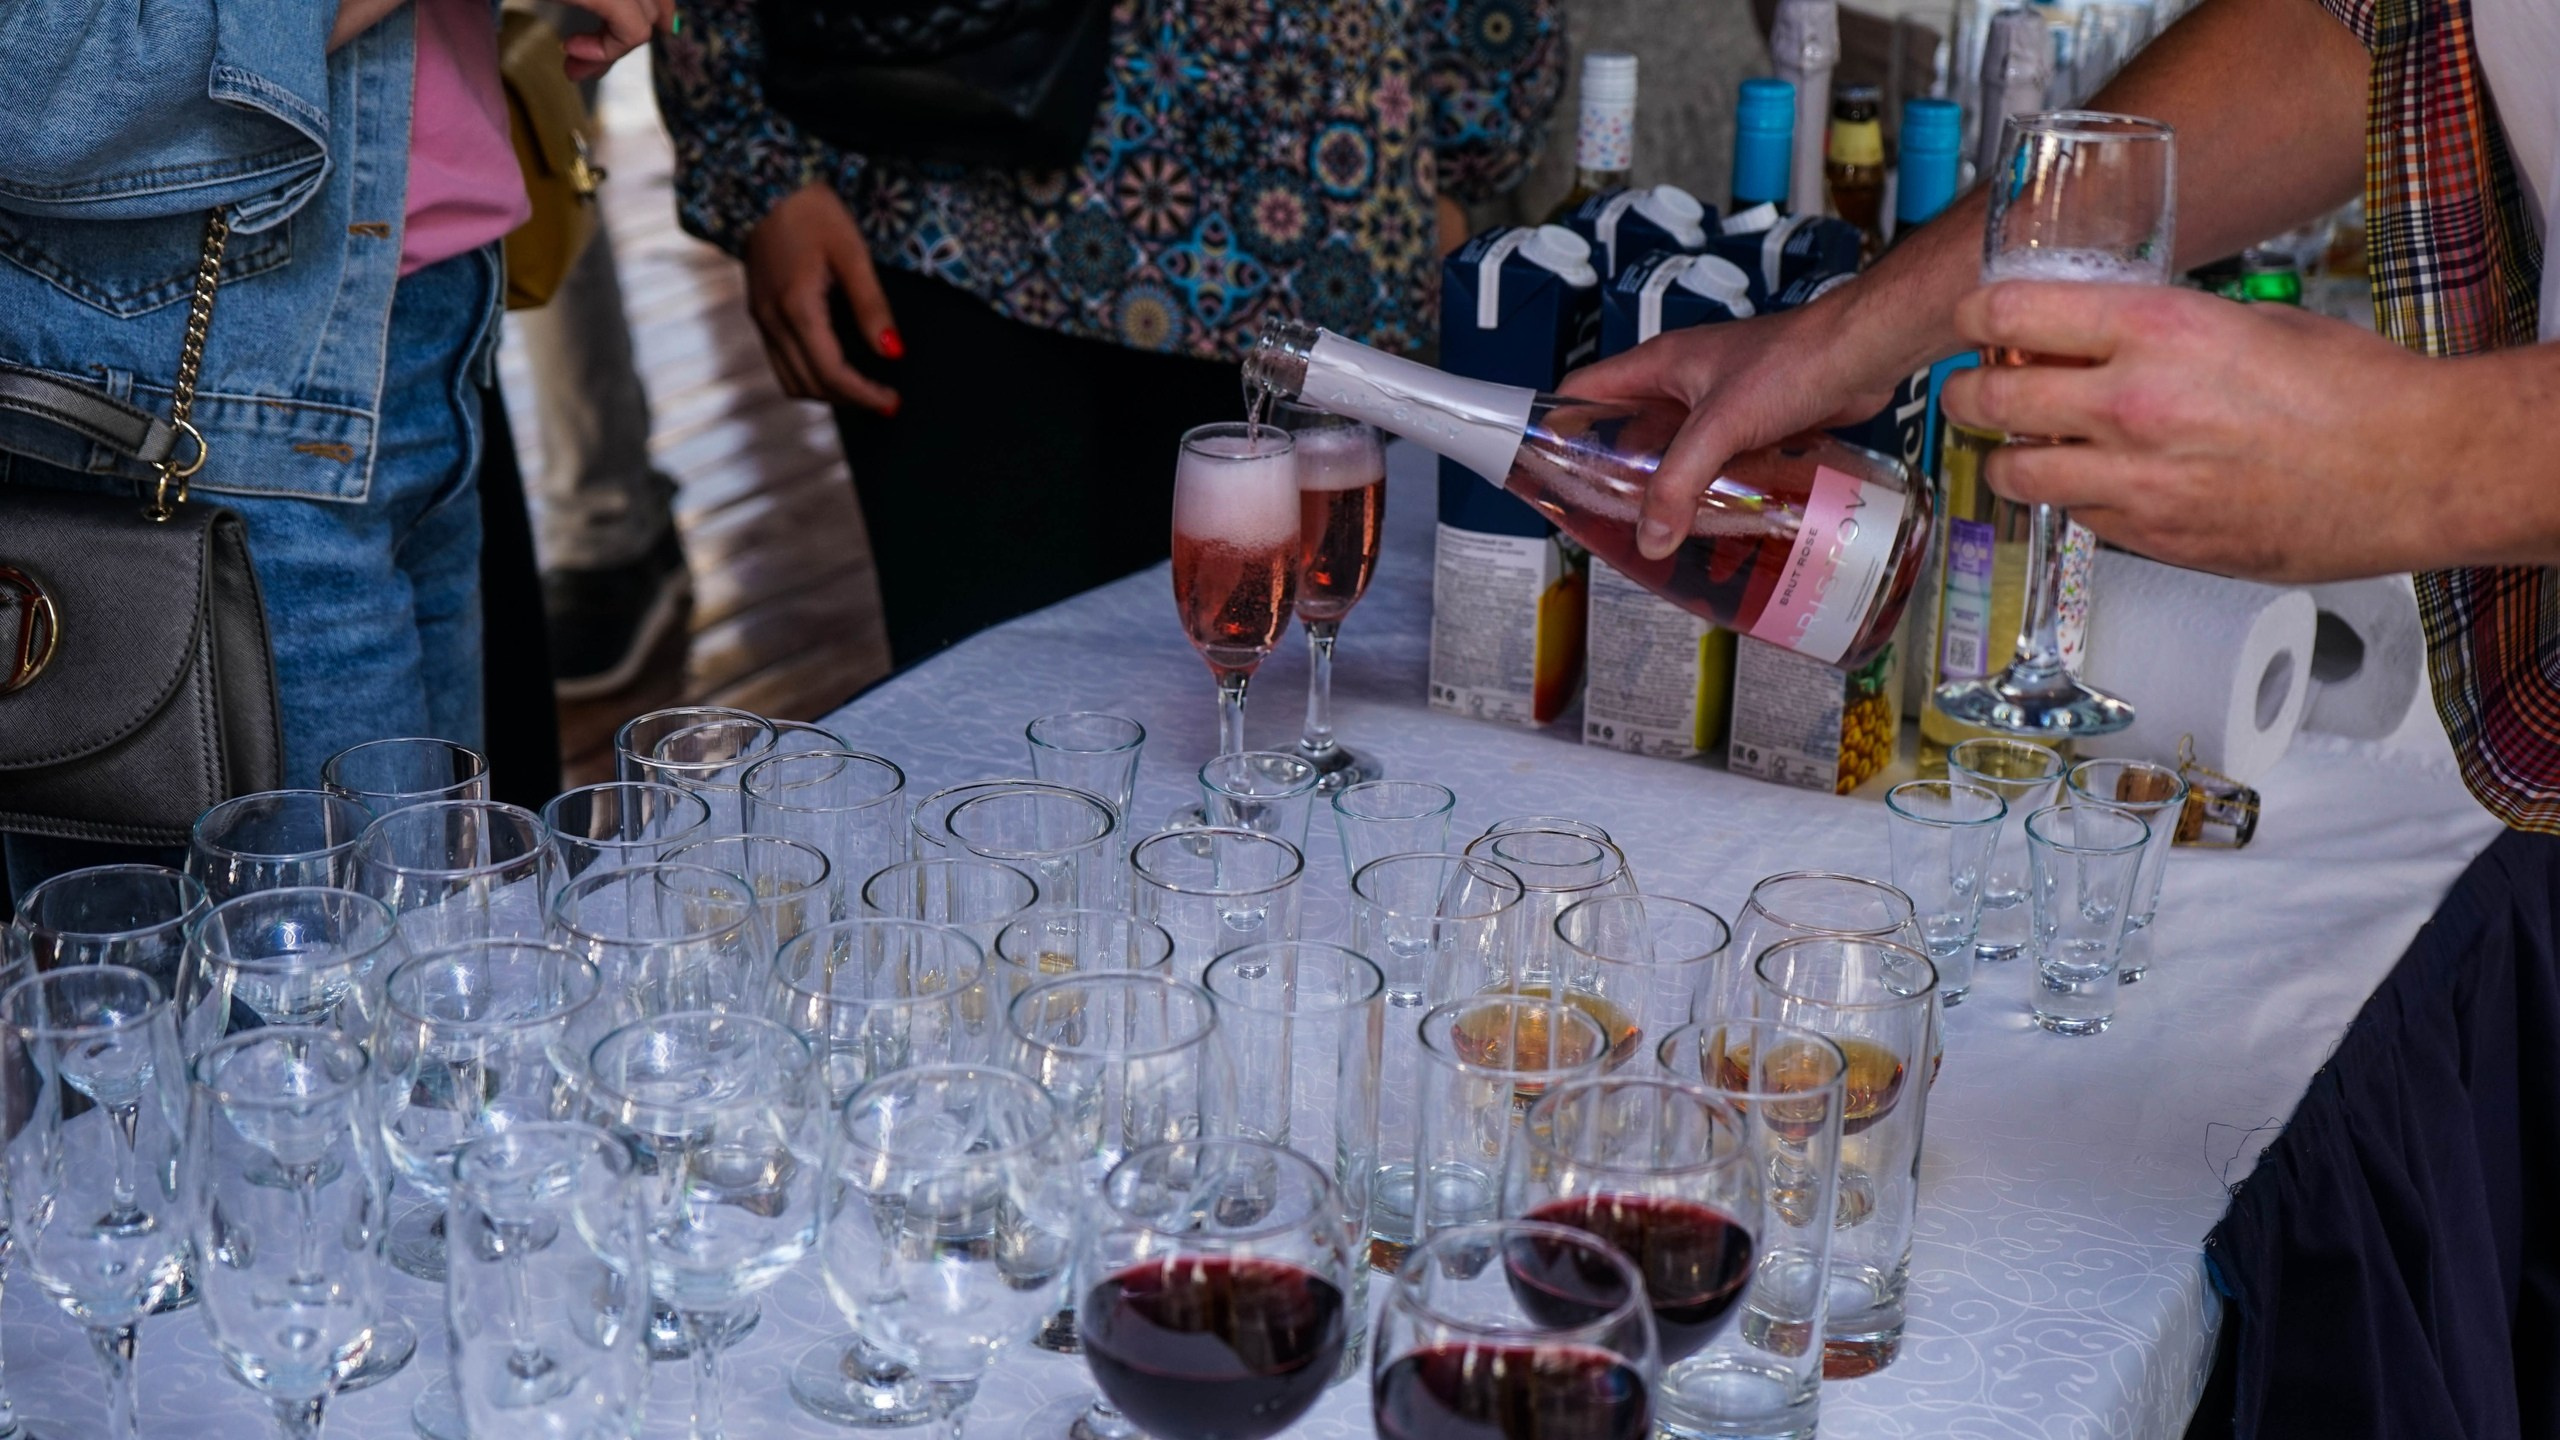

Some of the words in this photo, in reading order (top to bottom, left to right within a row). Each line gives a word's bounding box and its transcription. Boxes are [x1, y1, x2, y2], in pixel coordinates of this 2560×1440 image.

[1780, 571, 1803, 606] BRUT
[1800, 528, 1818, 568] ROSE
[1787, 489, 1867, 651] ARISTOV
